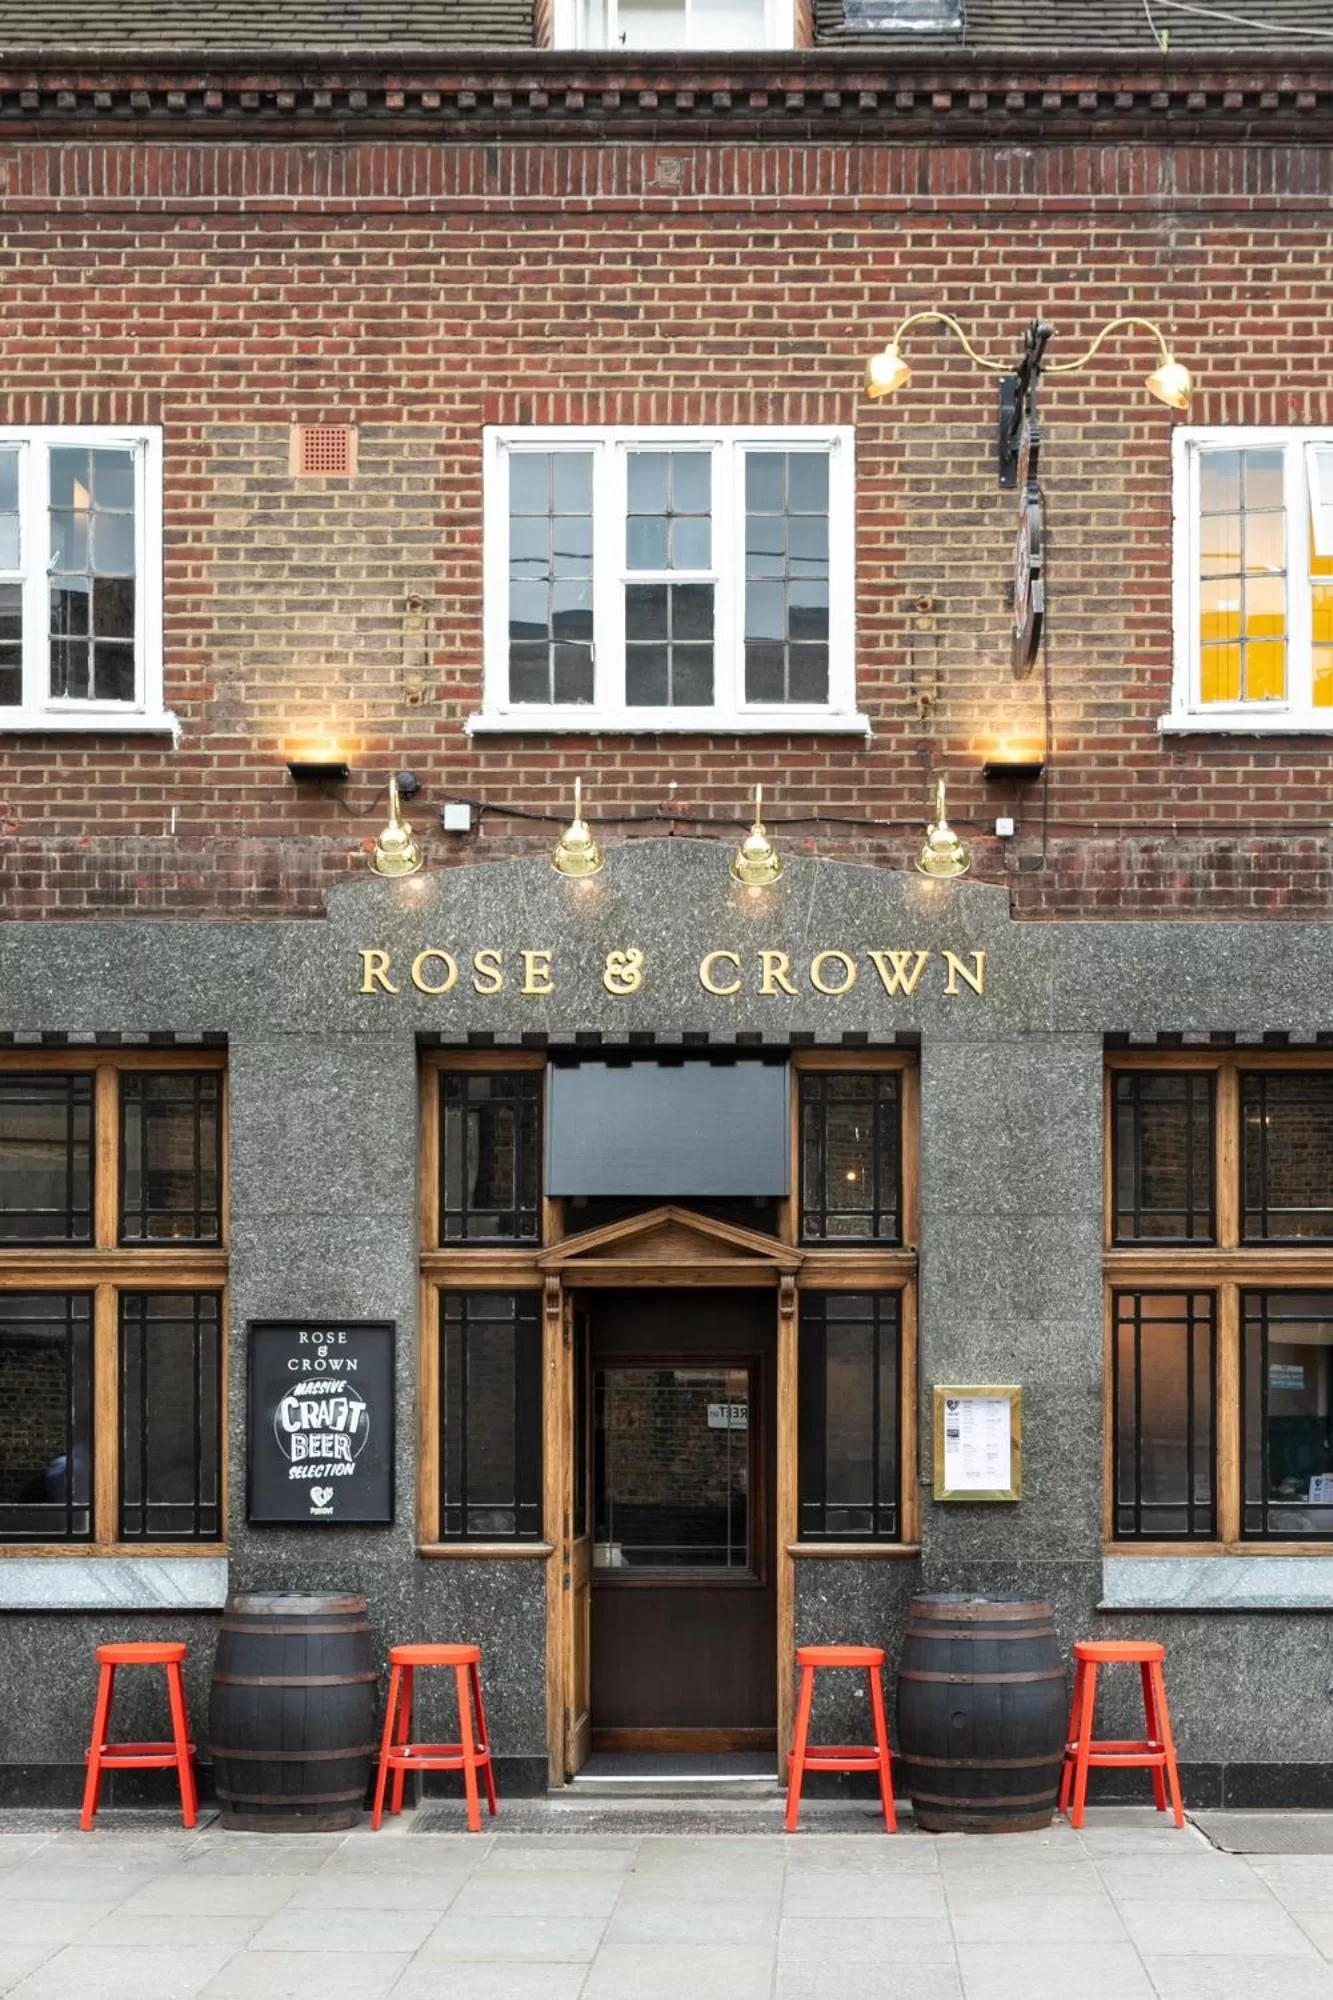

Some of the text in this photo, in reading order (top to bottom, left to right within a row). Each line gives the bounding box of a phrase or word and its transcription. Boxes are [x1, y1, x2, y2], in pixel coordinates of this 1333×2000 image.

[358, 948, 986, 997] ROSE & CROWN
[299, 1332, 347, 1343] ROSE
[317, 1345, 328, 1357] &
[287, 1358, 358, 1370] CROWN
[293, 1380, 347, 1396] MASSIVE
[281, 1396, 366, 1433] CRAFT
[291, 1433, 352, 1462] BEER
[288, 1462, 355, 1479] SELECTION
